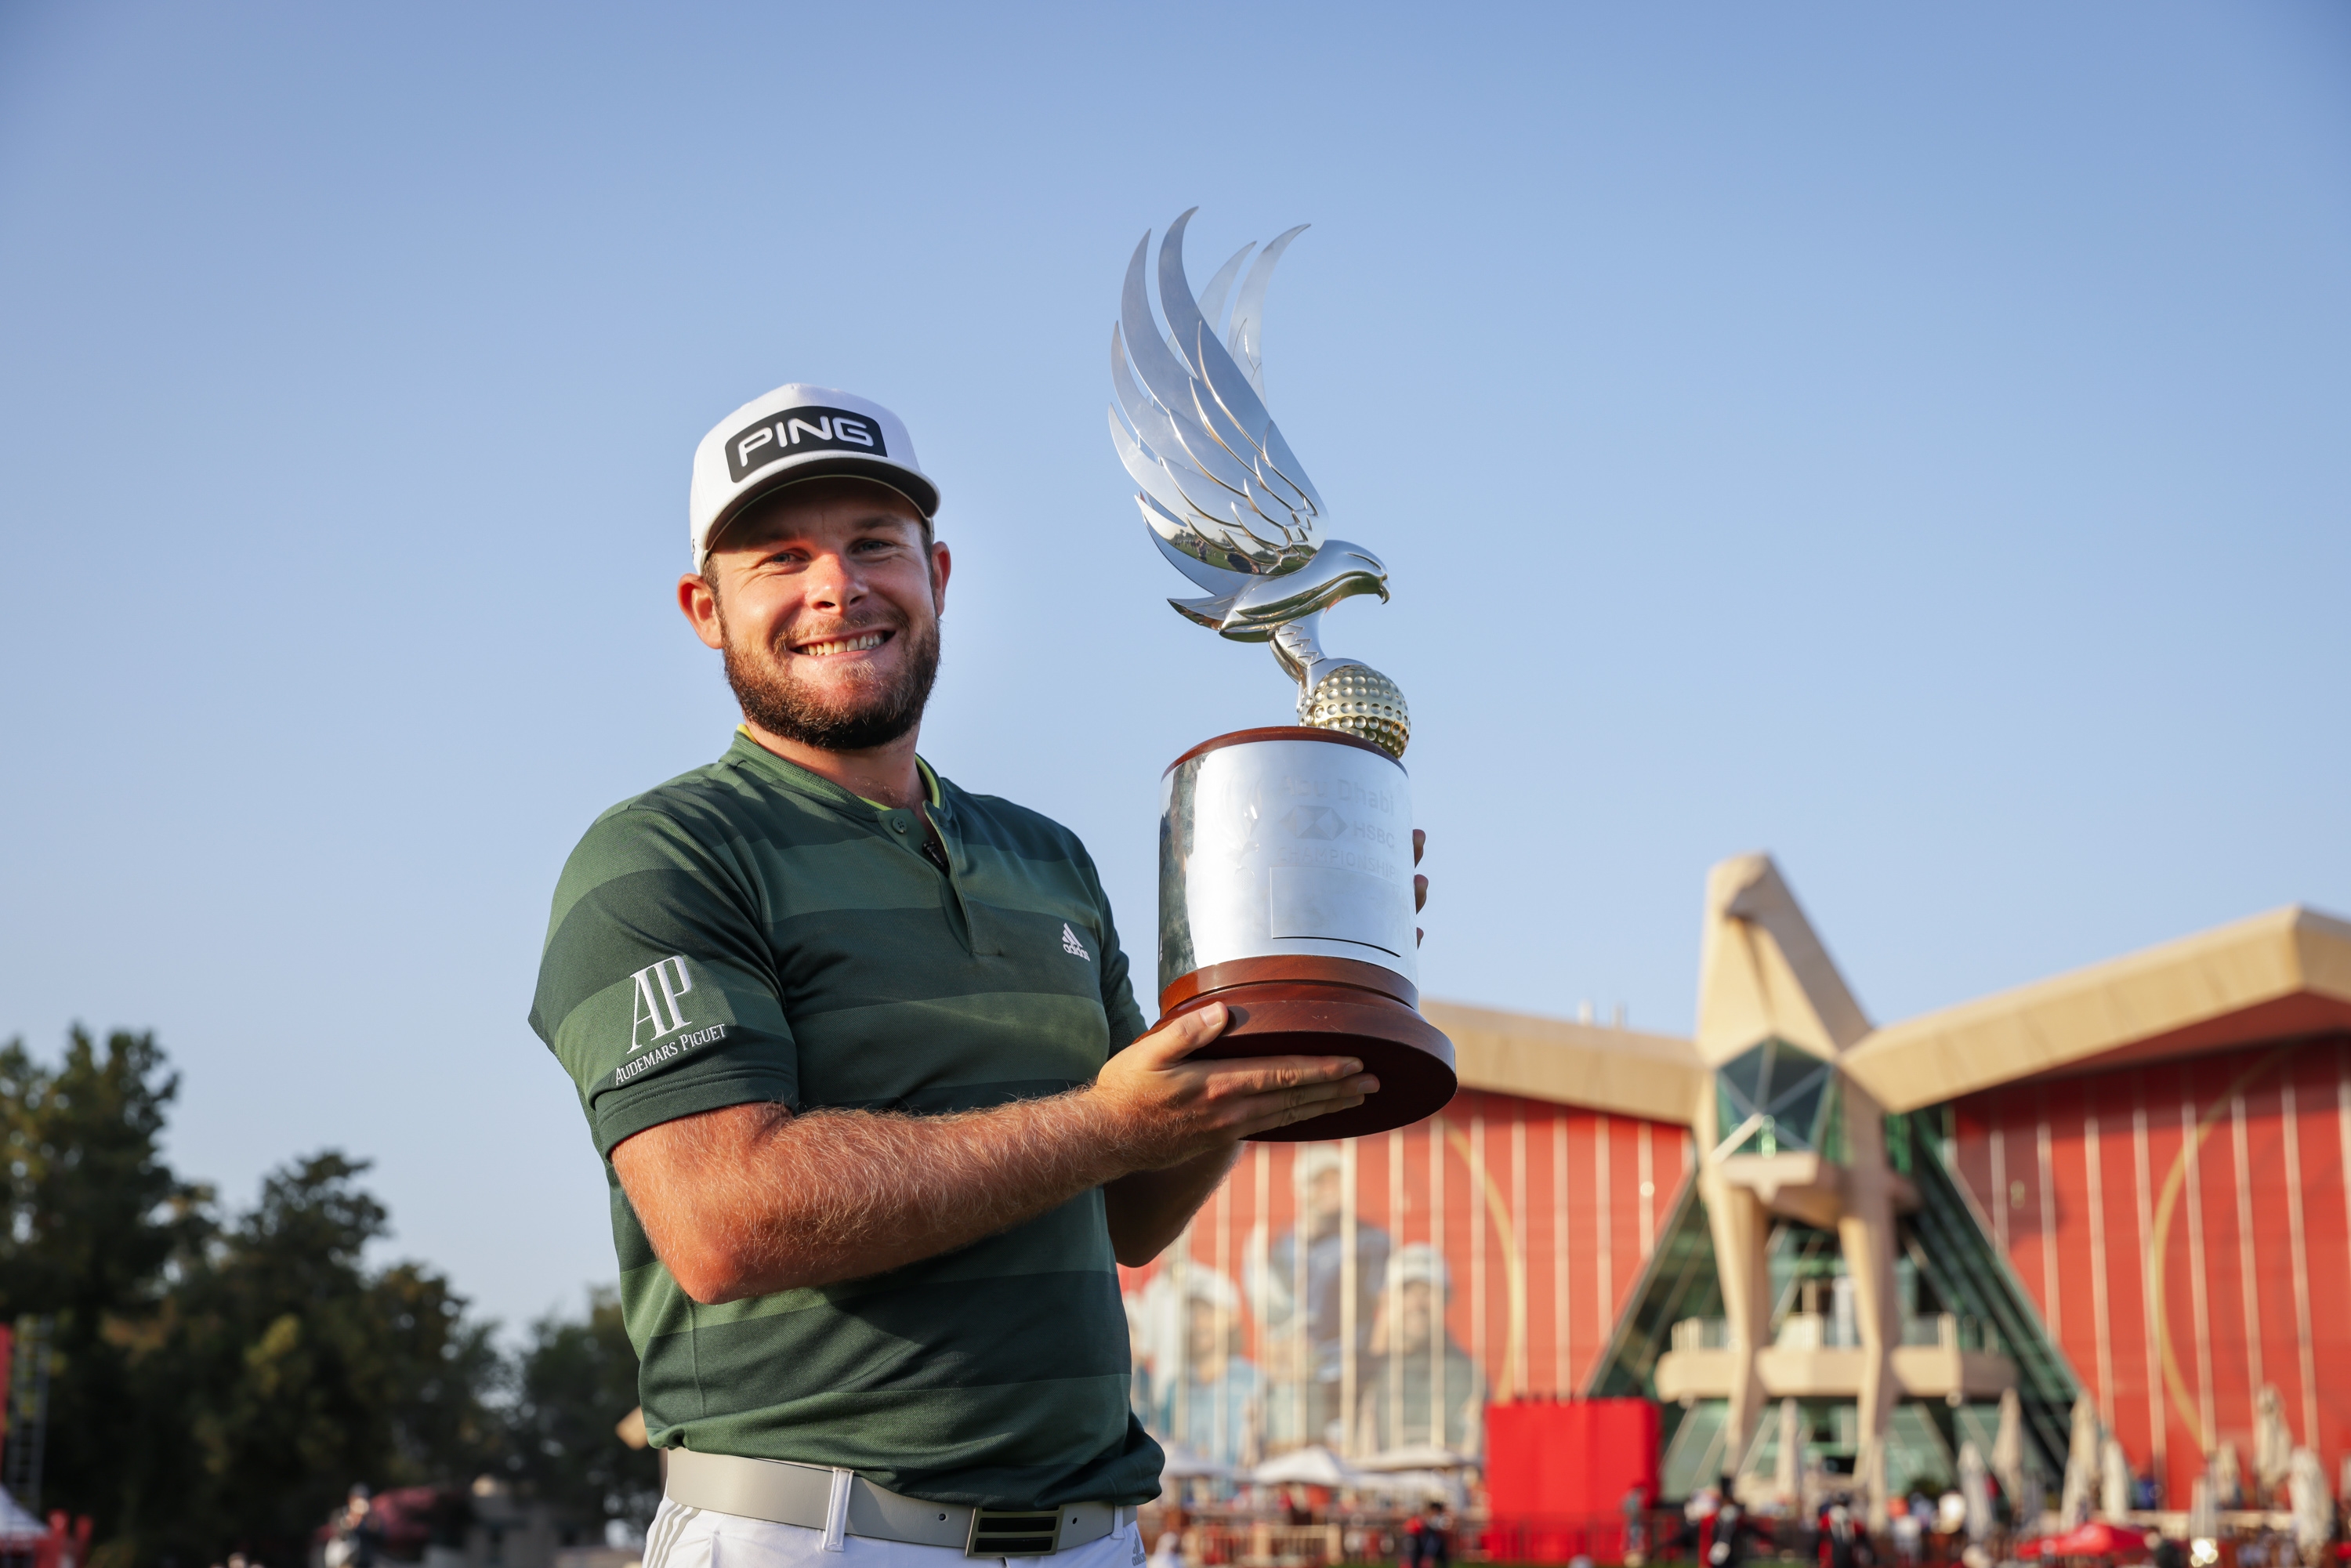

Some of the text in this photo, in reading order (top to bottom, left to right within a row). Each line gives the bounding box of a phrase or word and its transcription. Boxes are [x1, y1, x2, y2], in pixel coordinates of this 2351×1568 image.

[737, 415, 875, 467] PING
[1279, 775, 1395, 816] Abu Dhabi
[1353, 821, 1395, 849] HSBC
[1277, 846, 1396, 878] CHAMPIONSHIP
[1063, 943, 1090, 961] adidas
[627, 955, 693, 1055] AP
[615, 1023, 726, 1085] AUDEMARS PIGUET
